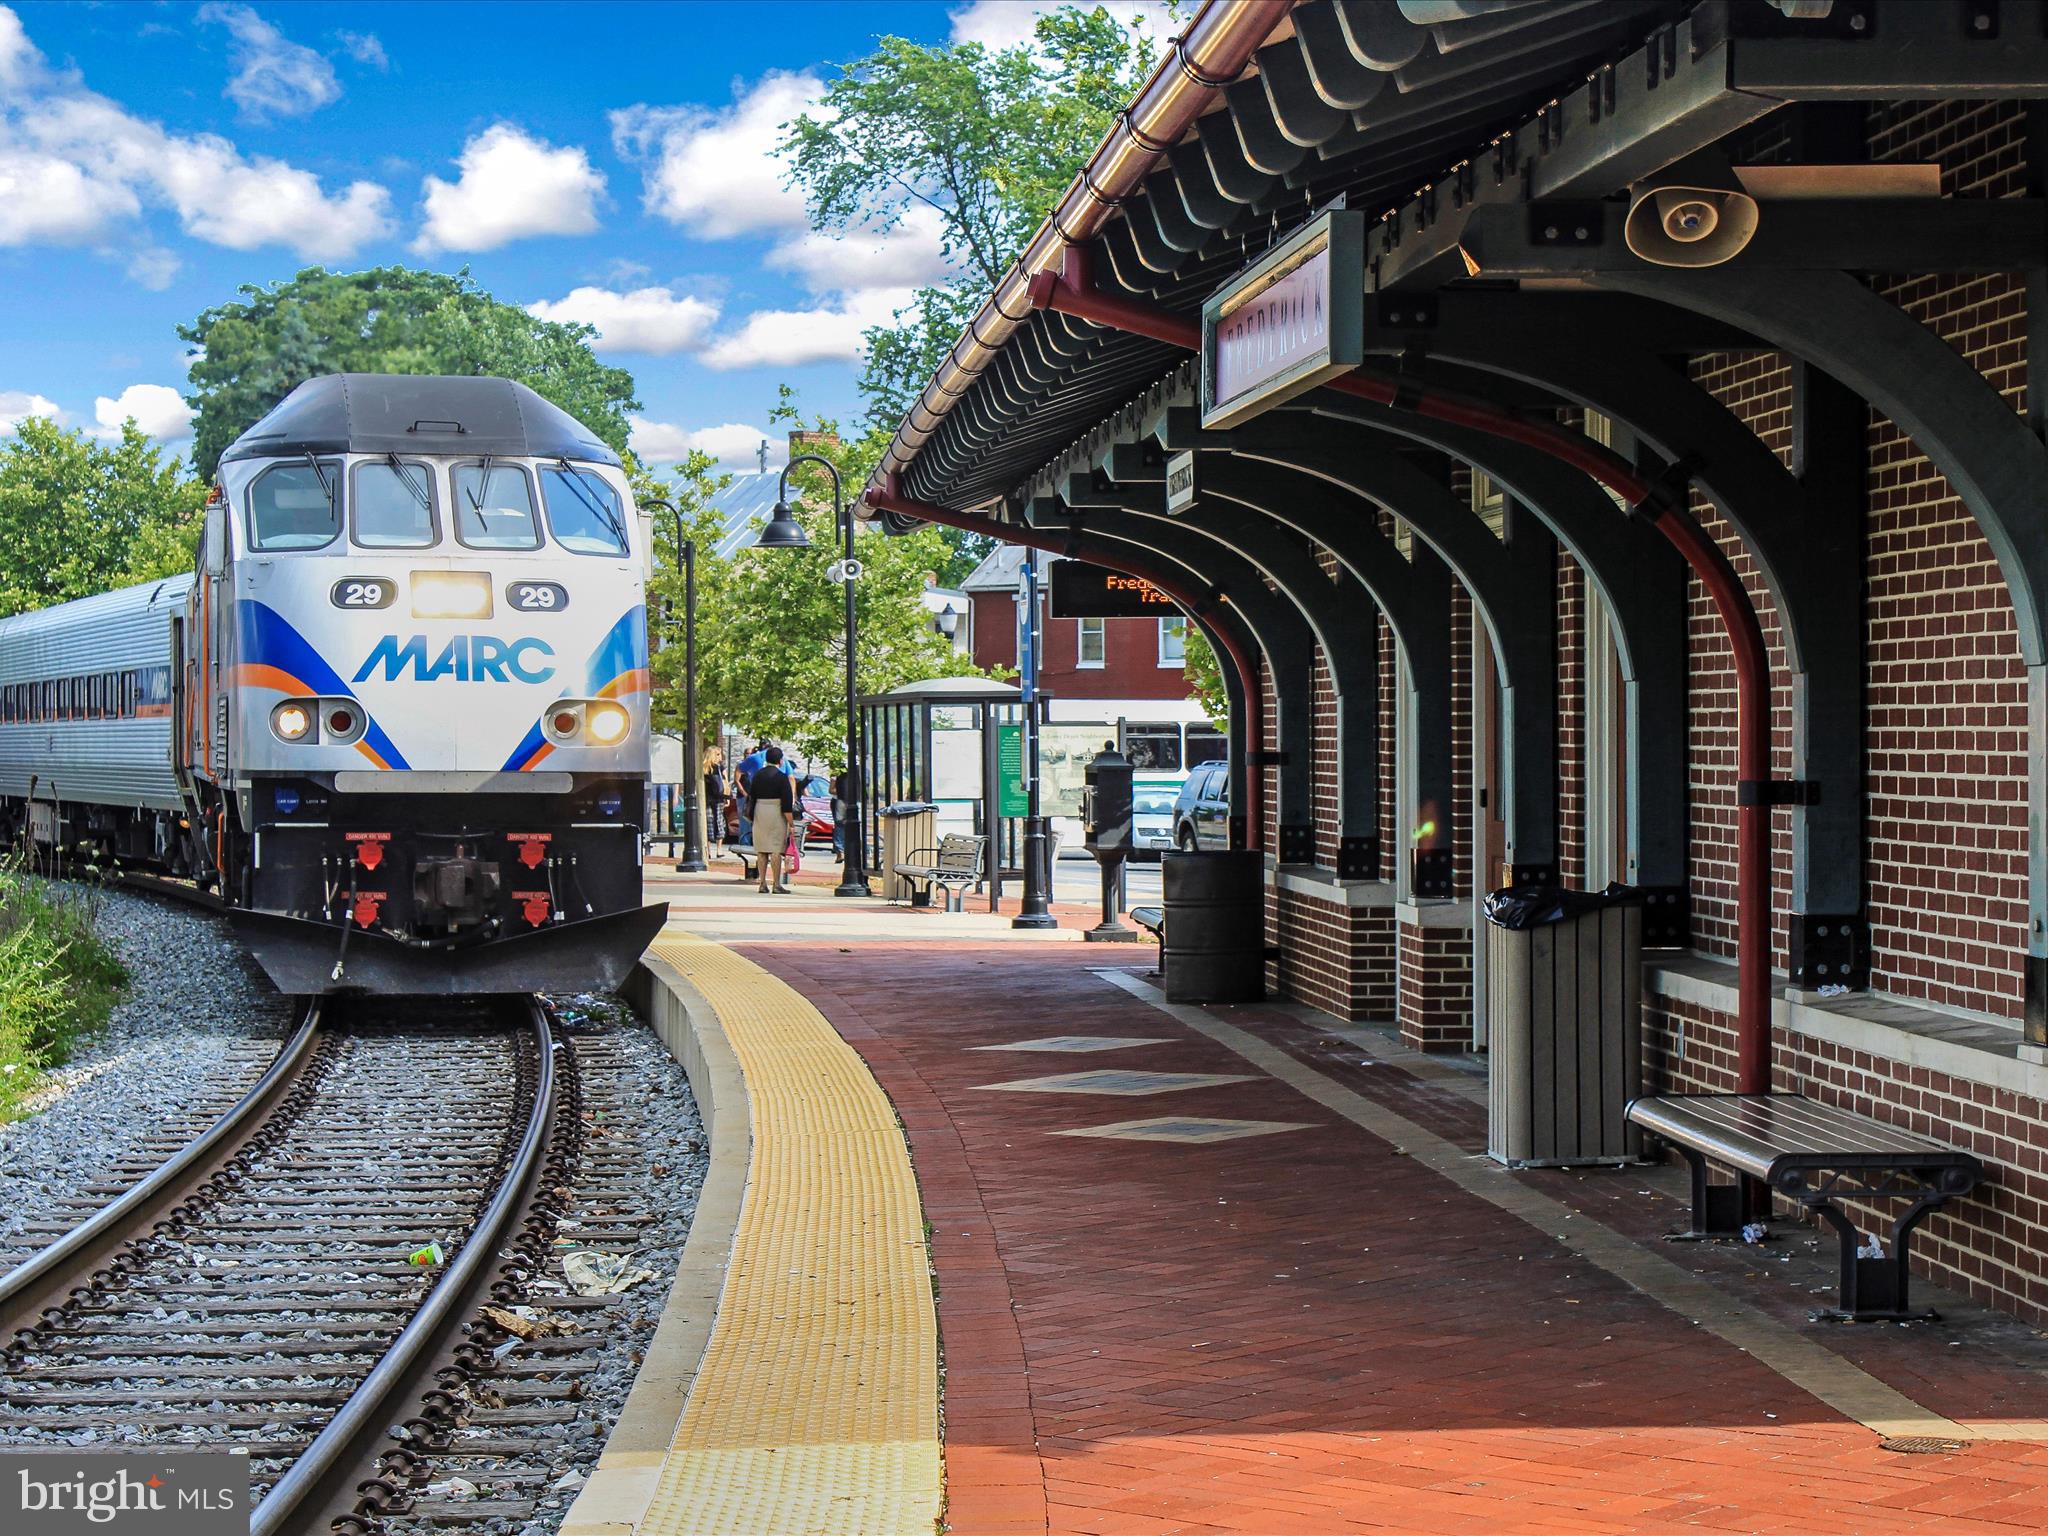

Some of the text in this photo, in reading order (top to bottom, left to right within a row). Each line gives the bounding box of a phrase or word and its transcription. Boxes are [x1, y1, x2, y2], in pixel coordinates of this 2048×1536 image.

[1226, 268, 1324, 383] FREDERICK
[345, 584, 382, 605] 29
[519, 586, 556, 608] 29
[1140, 589, 1171, 602] Tra
[351, 634, 557, 685] MARC
